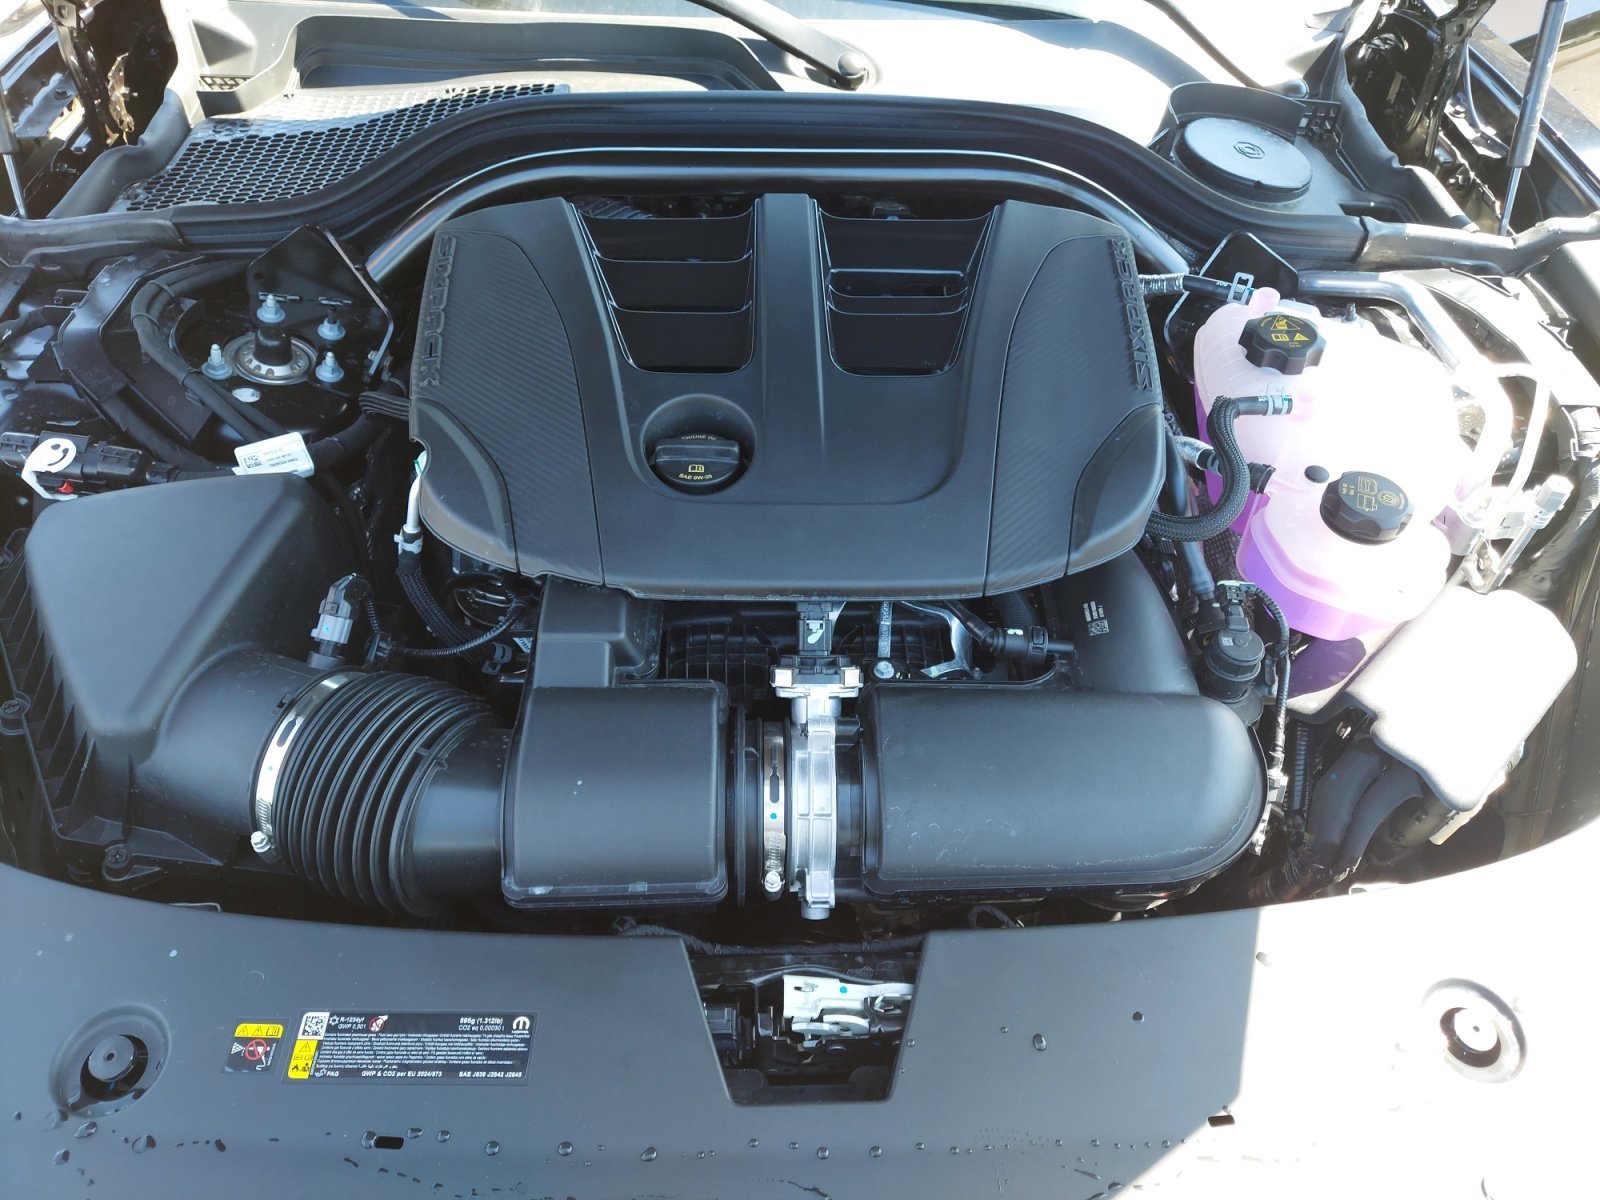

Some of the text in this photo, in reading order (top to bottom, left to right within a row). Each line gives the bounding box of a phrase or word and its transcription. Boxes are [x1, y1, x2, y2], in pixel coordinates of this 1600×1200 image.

[419, 234, 457, 388] SIXPACK
[1111, 237, 1153, 392] SIXPACK
[340, 1016, 365, 1024] R-1234yf
